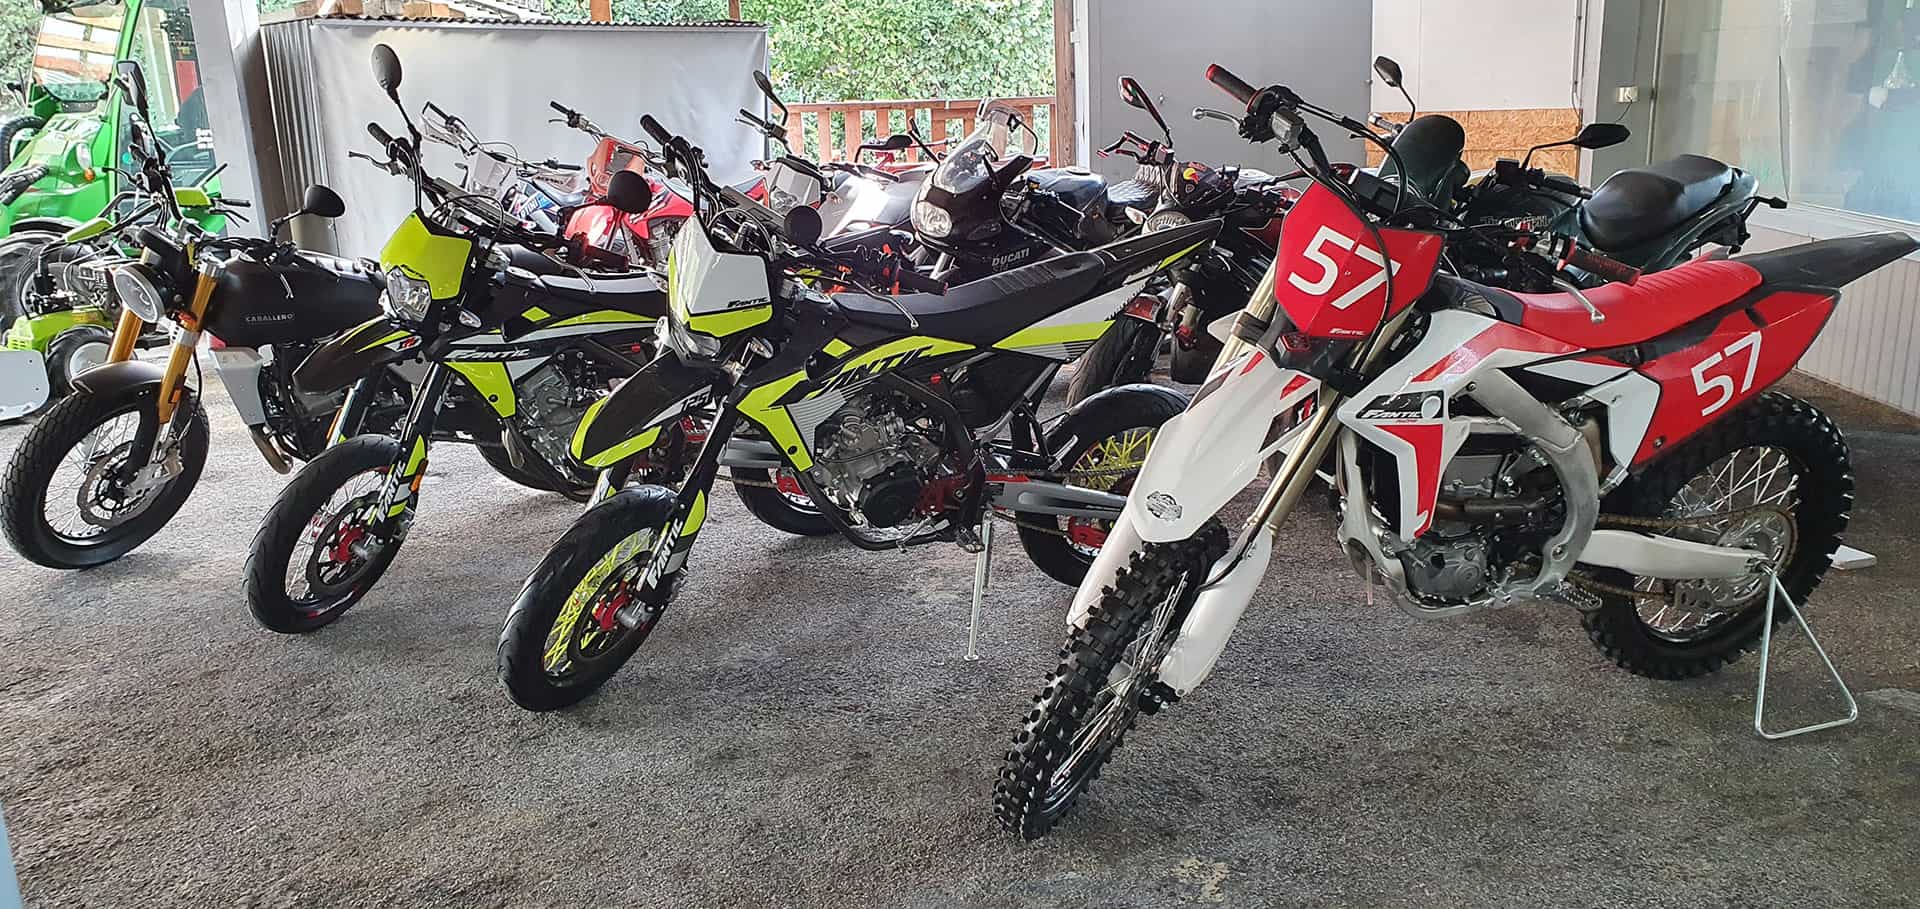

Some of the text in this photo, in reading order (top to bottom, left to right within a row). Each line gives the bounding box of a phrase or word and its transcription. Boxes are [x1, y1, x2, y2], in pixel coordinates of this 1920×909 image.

[992, 247, 1030, 266] DUCATI
[1288, 225, 1401, 310] 57
[246, 313, 293, 322] CABALLERO
[727, 296, 768, 308] FANTIC
[1691, 331, 1762, 416] 57
[1361, 409, 1423, 418] FANTIC
[376, 460, 406, 523] FANTIC
[646, 518, 684, 590] FANTIC
